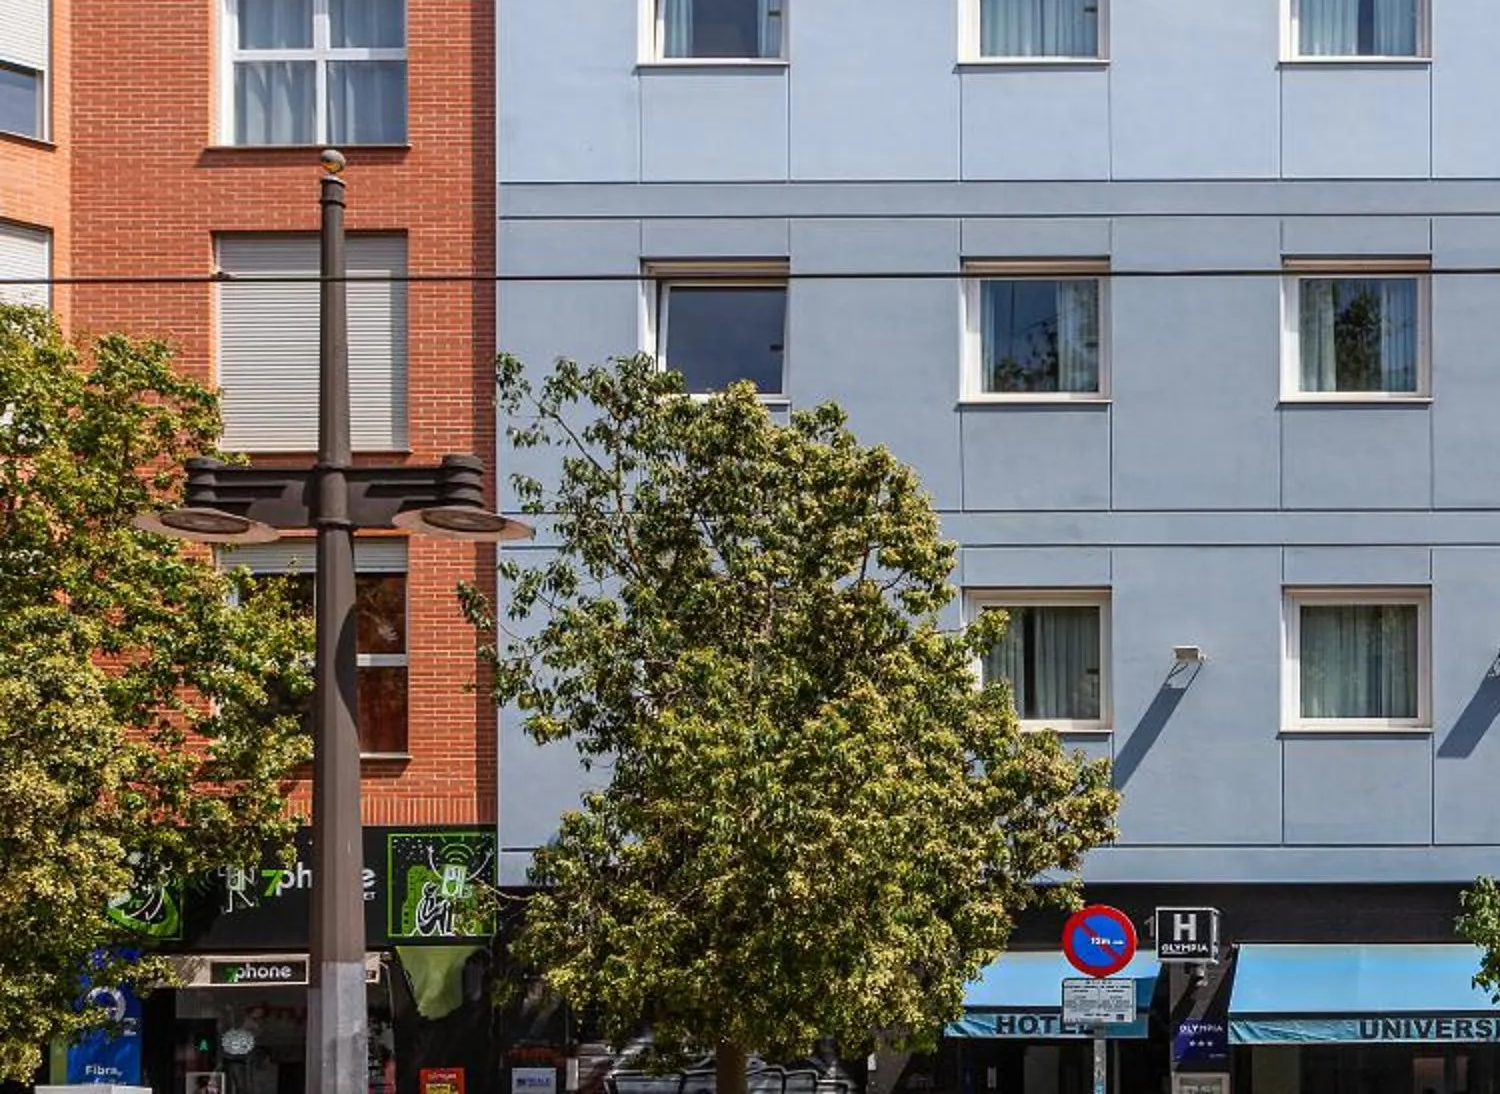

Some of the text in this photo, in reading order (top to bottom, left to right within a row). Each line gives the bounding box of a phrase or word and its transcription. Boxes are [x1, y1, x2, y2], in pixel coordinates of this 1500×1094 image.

[261, 862, 376, 896] 7phe
[1173, 913, 1197, 941] H
[1161, 943, 1209, 953] OLYMPIA
[1180, 1024, 1223, 1034] OLYMPIA
